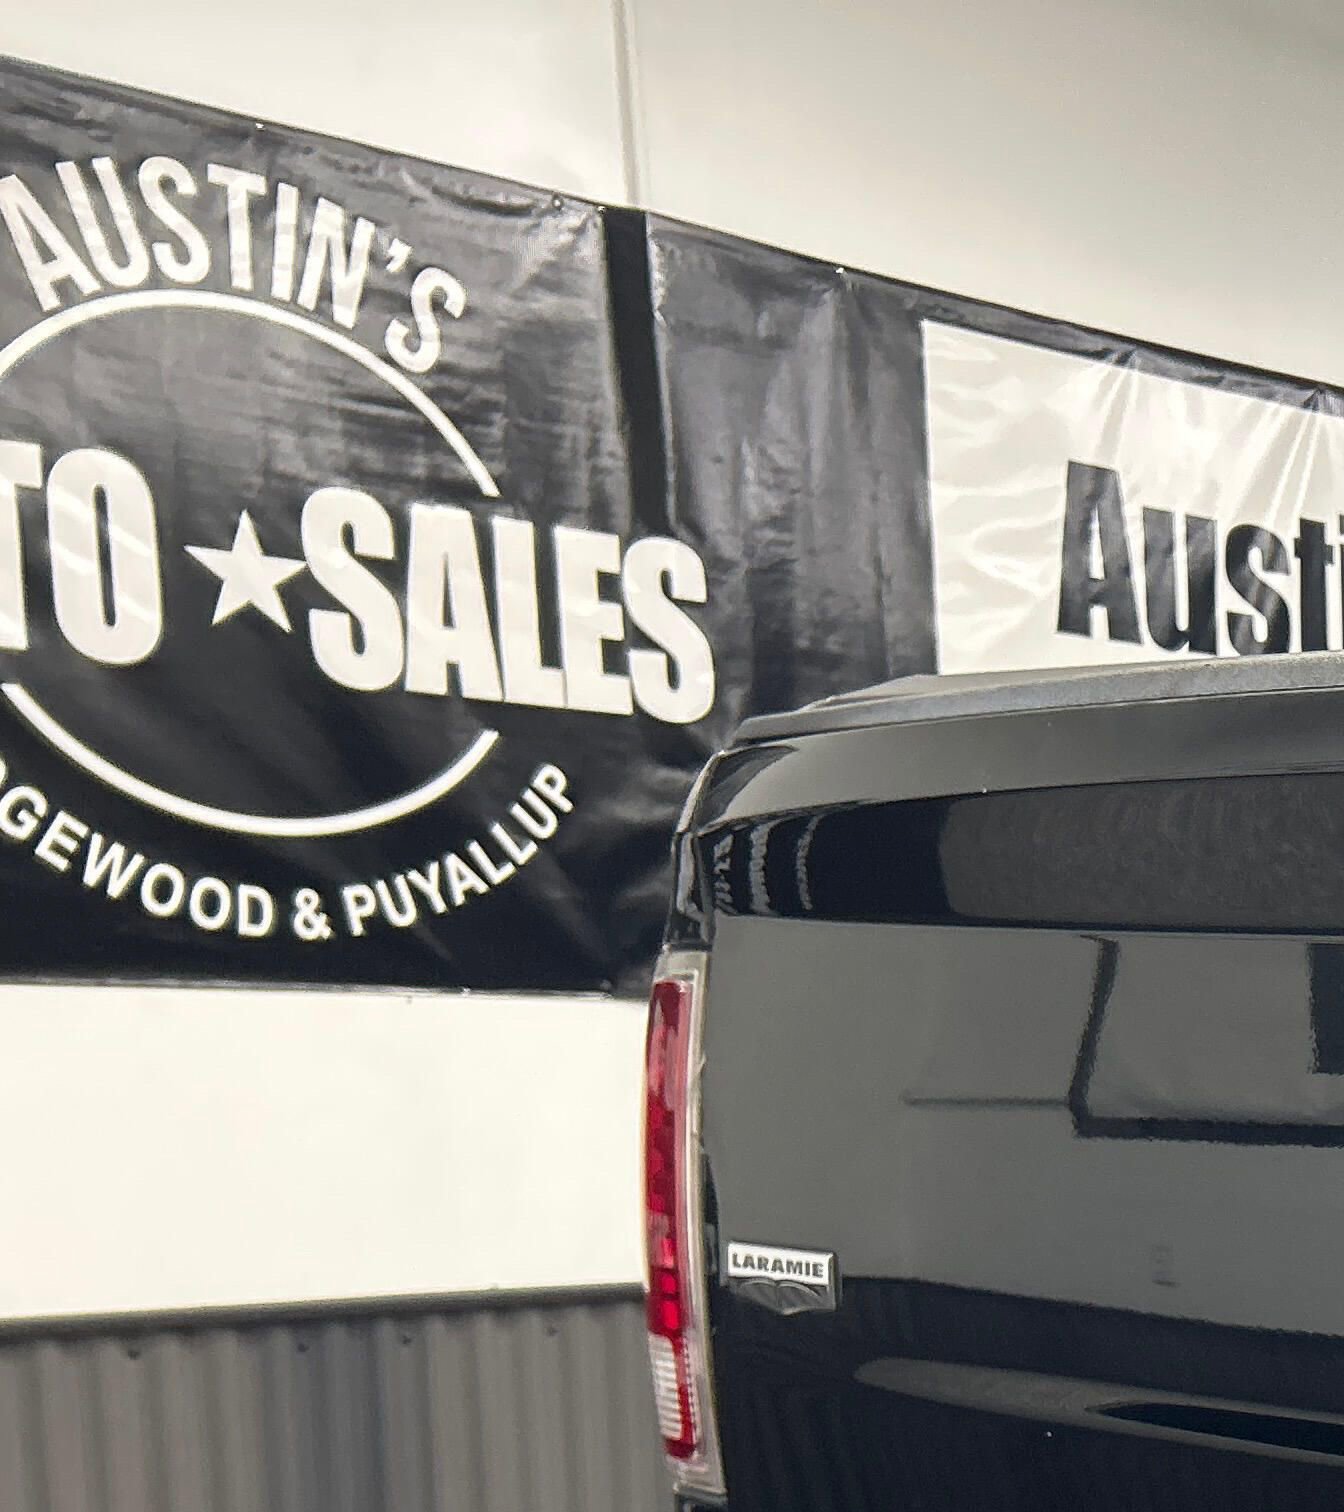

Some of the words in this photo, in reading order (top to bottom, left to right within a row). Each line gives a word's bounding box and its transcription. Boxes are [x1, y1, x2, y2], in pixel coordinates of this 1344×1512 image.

[0, 156, 467, 374] AUSTIN'S
[301, 486, 715, 724] SALES
[0, 757, 275, 938] GEWOOD
[293, 887, 332, 941] &
[341, 763, 574, 937] PUYALLUP
[731, 1252, 825, 1279] LARAMIE
